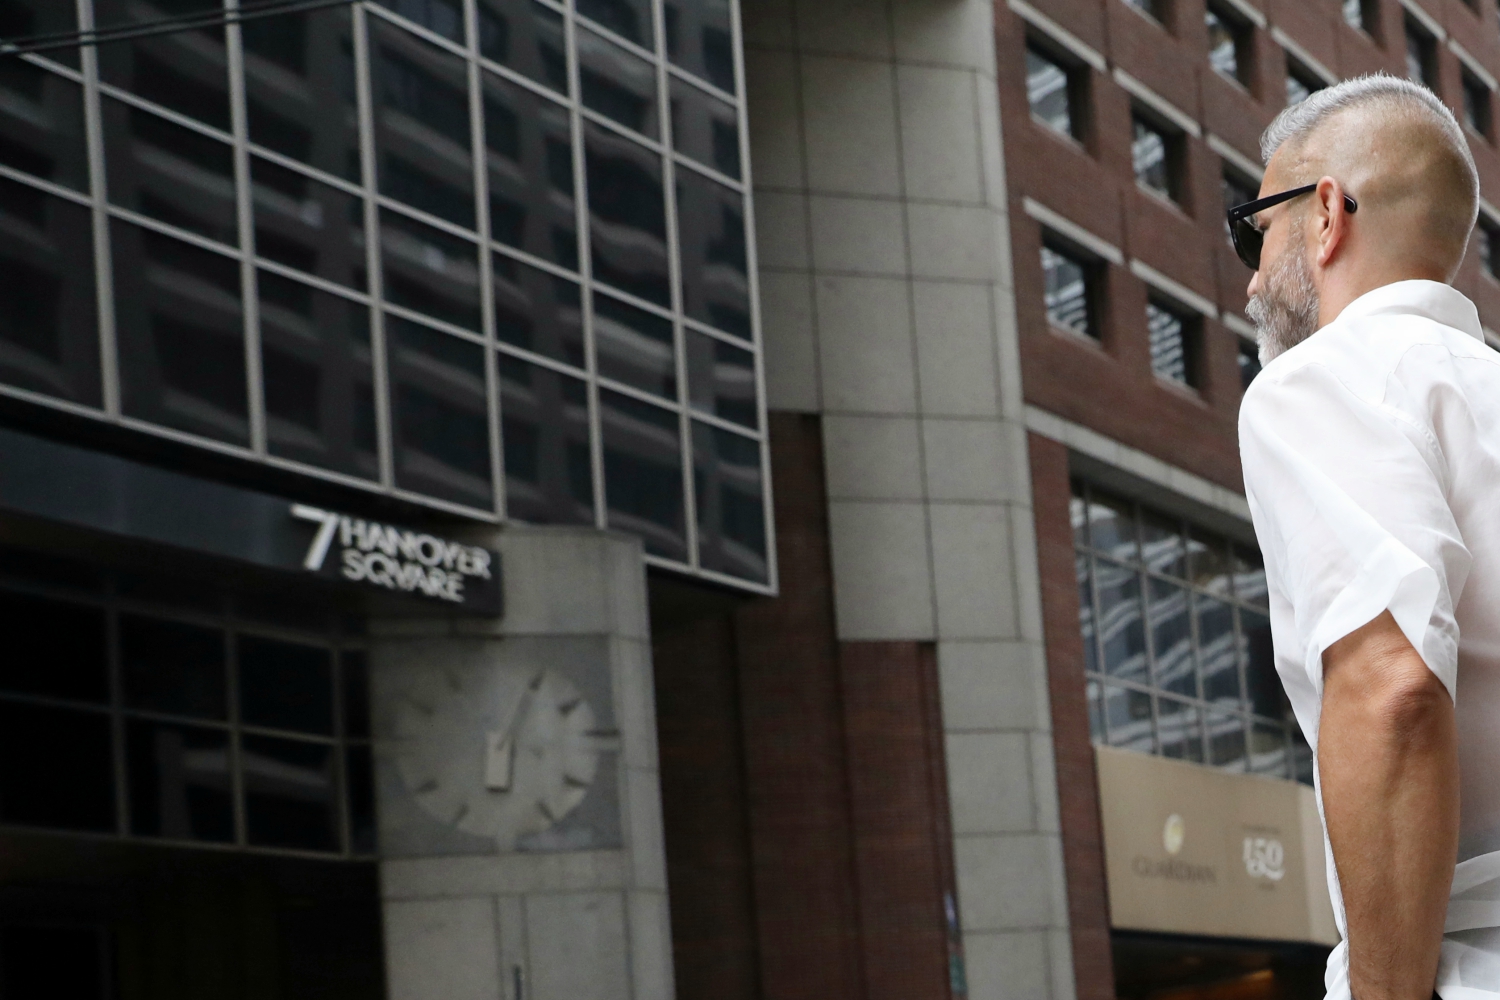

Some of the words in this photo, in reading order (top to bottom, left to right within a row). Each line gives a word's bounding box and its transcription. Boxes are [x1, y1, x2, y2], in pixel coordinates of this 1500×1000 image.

[290, 503, 340, 571] 7
[340, 517, 491, 580] HANOVER
[342, 548, 465, 602] SQUARE
